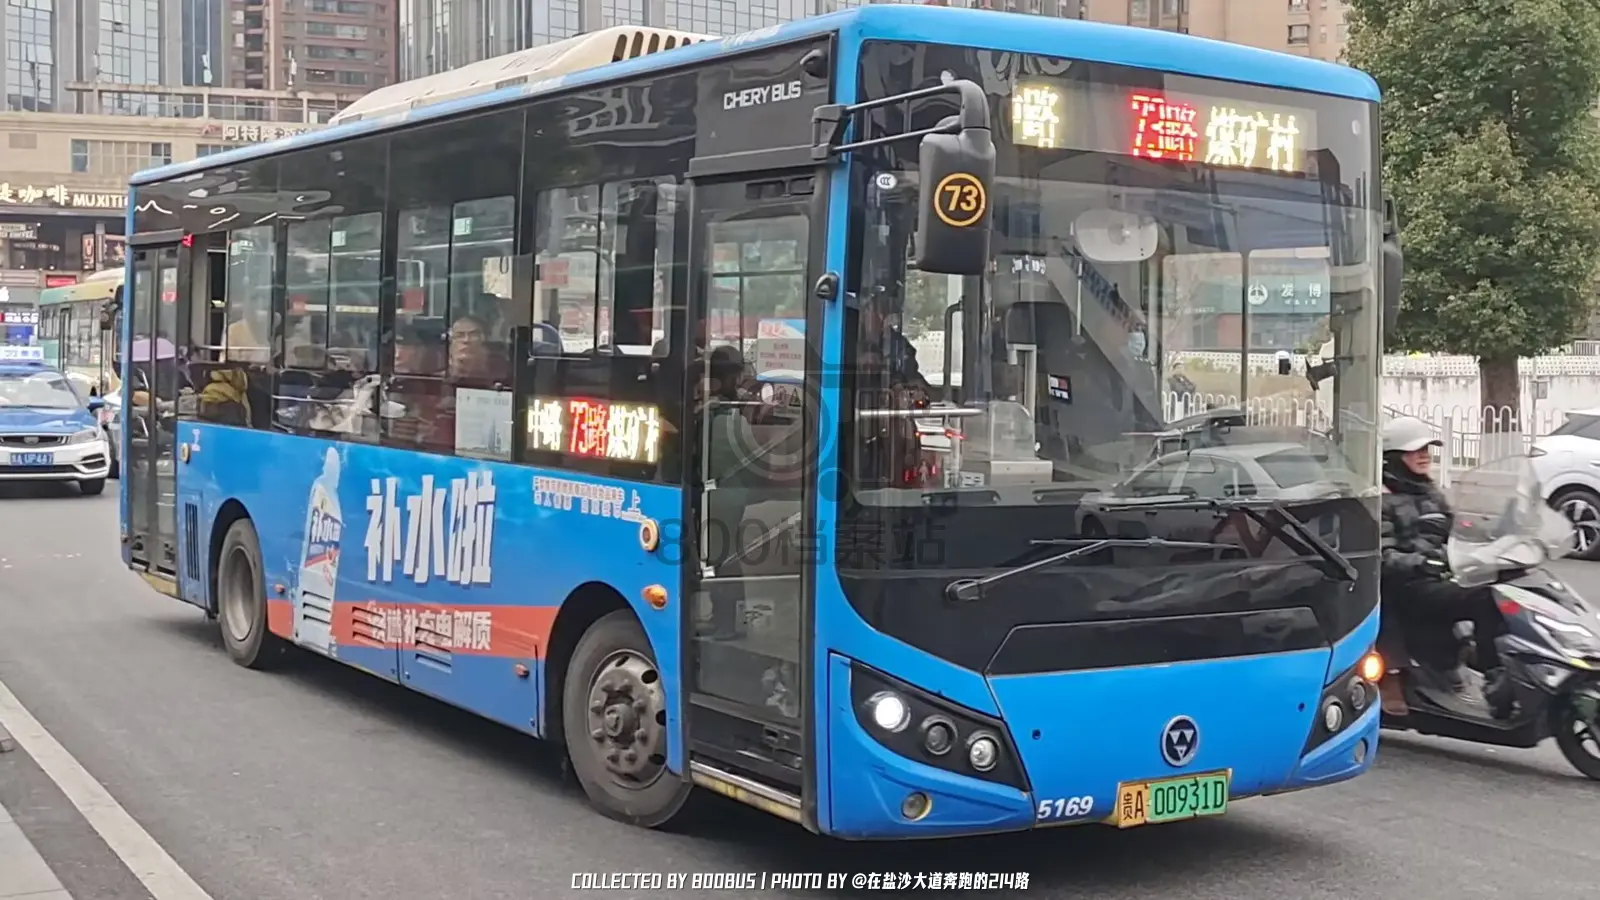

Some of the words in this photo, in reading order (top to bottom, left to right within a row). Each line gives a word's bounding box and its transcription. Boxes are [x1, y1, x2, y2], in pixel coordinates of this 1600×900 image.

[724, 85, 770, 110] CHERY
[772, 80, 802, 102] BUS
[1131, 94, 1199, 161] 73路
[1205, 106, 1300, 172] 煤矿村
[944, 184, 977, 212] 73
[364, 470, 496, 586] 补水啦
[1037, 796, 1093, 819] 5169
[1154, 780, 1225, 816] 00931D
